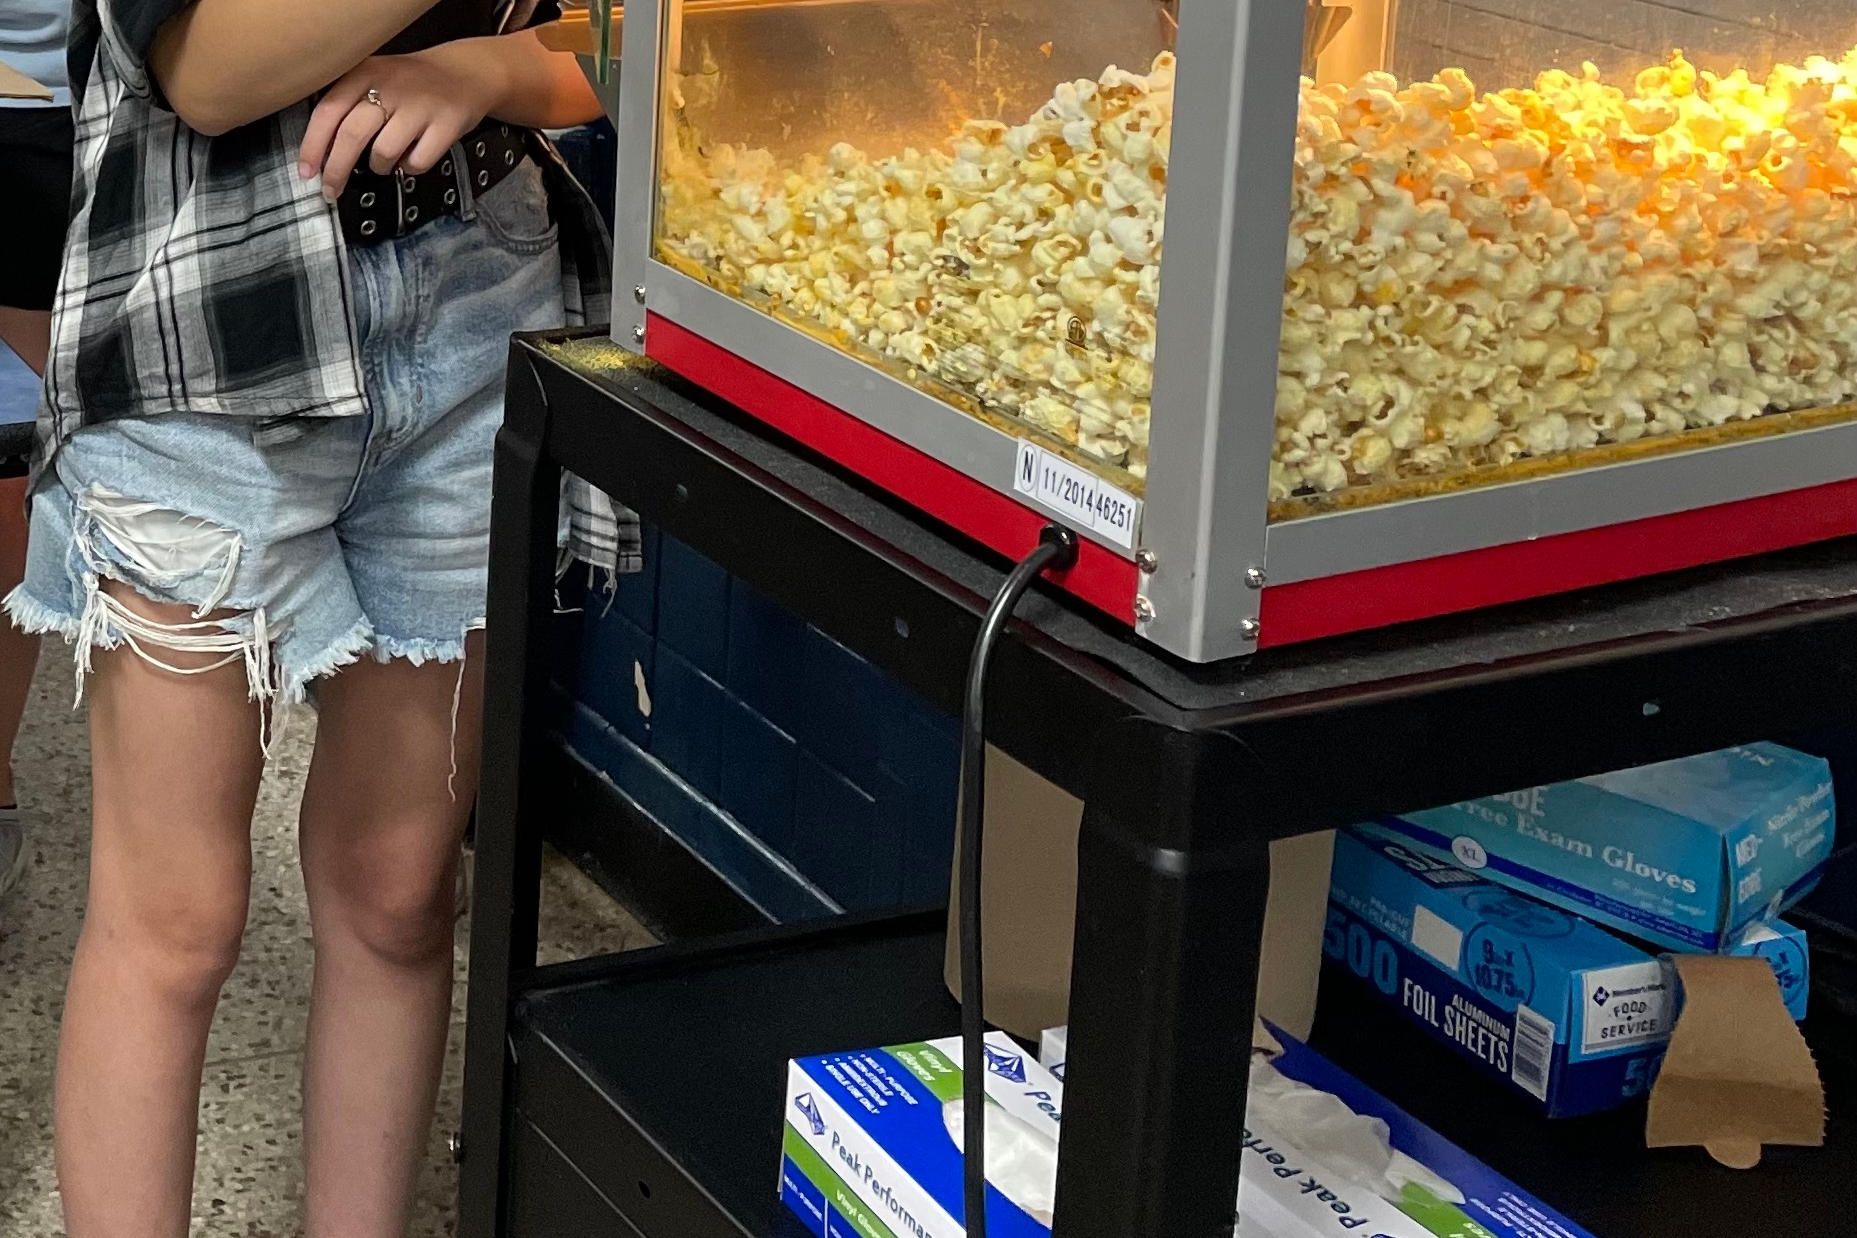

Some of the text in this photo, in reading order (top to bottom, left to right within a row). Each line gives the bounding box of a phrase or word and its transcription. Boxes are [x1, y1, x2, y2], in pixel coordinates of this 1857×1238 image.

[1022, 450, 1133, 532] N 11/2014 46251
[1516, 812, 1594, 858] Exam
[1601, 845, 1697, 895] Gloves
[1403, 977, 1509, 1073] FOIL SHEETS
[1452, 993, 1511, 1042] ALUMINUM
[1600, 1019, 1657, 1039] SERVICE
[1613, 1001, 1647, 1018] FOOD
[831, 1131, 862, 1178] Peak
[1297, 1176, 1370, 1228] Peak
